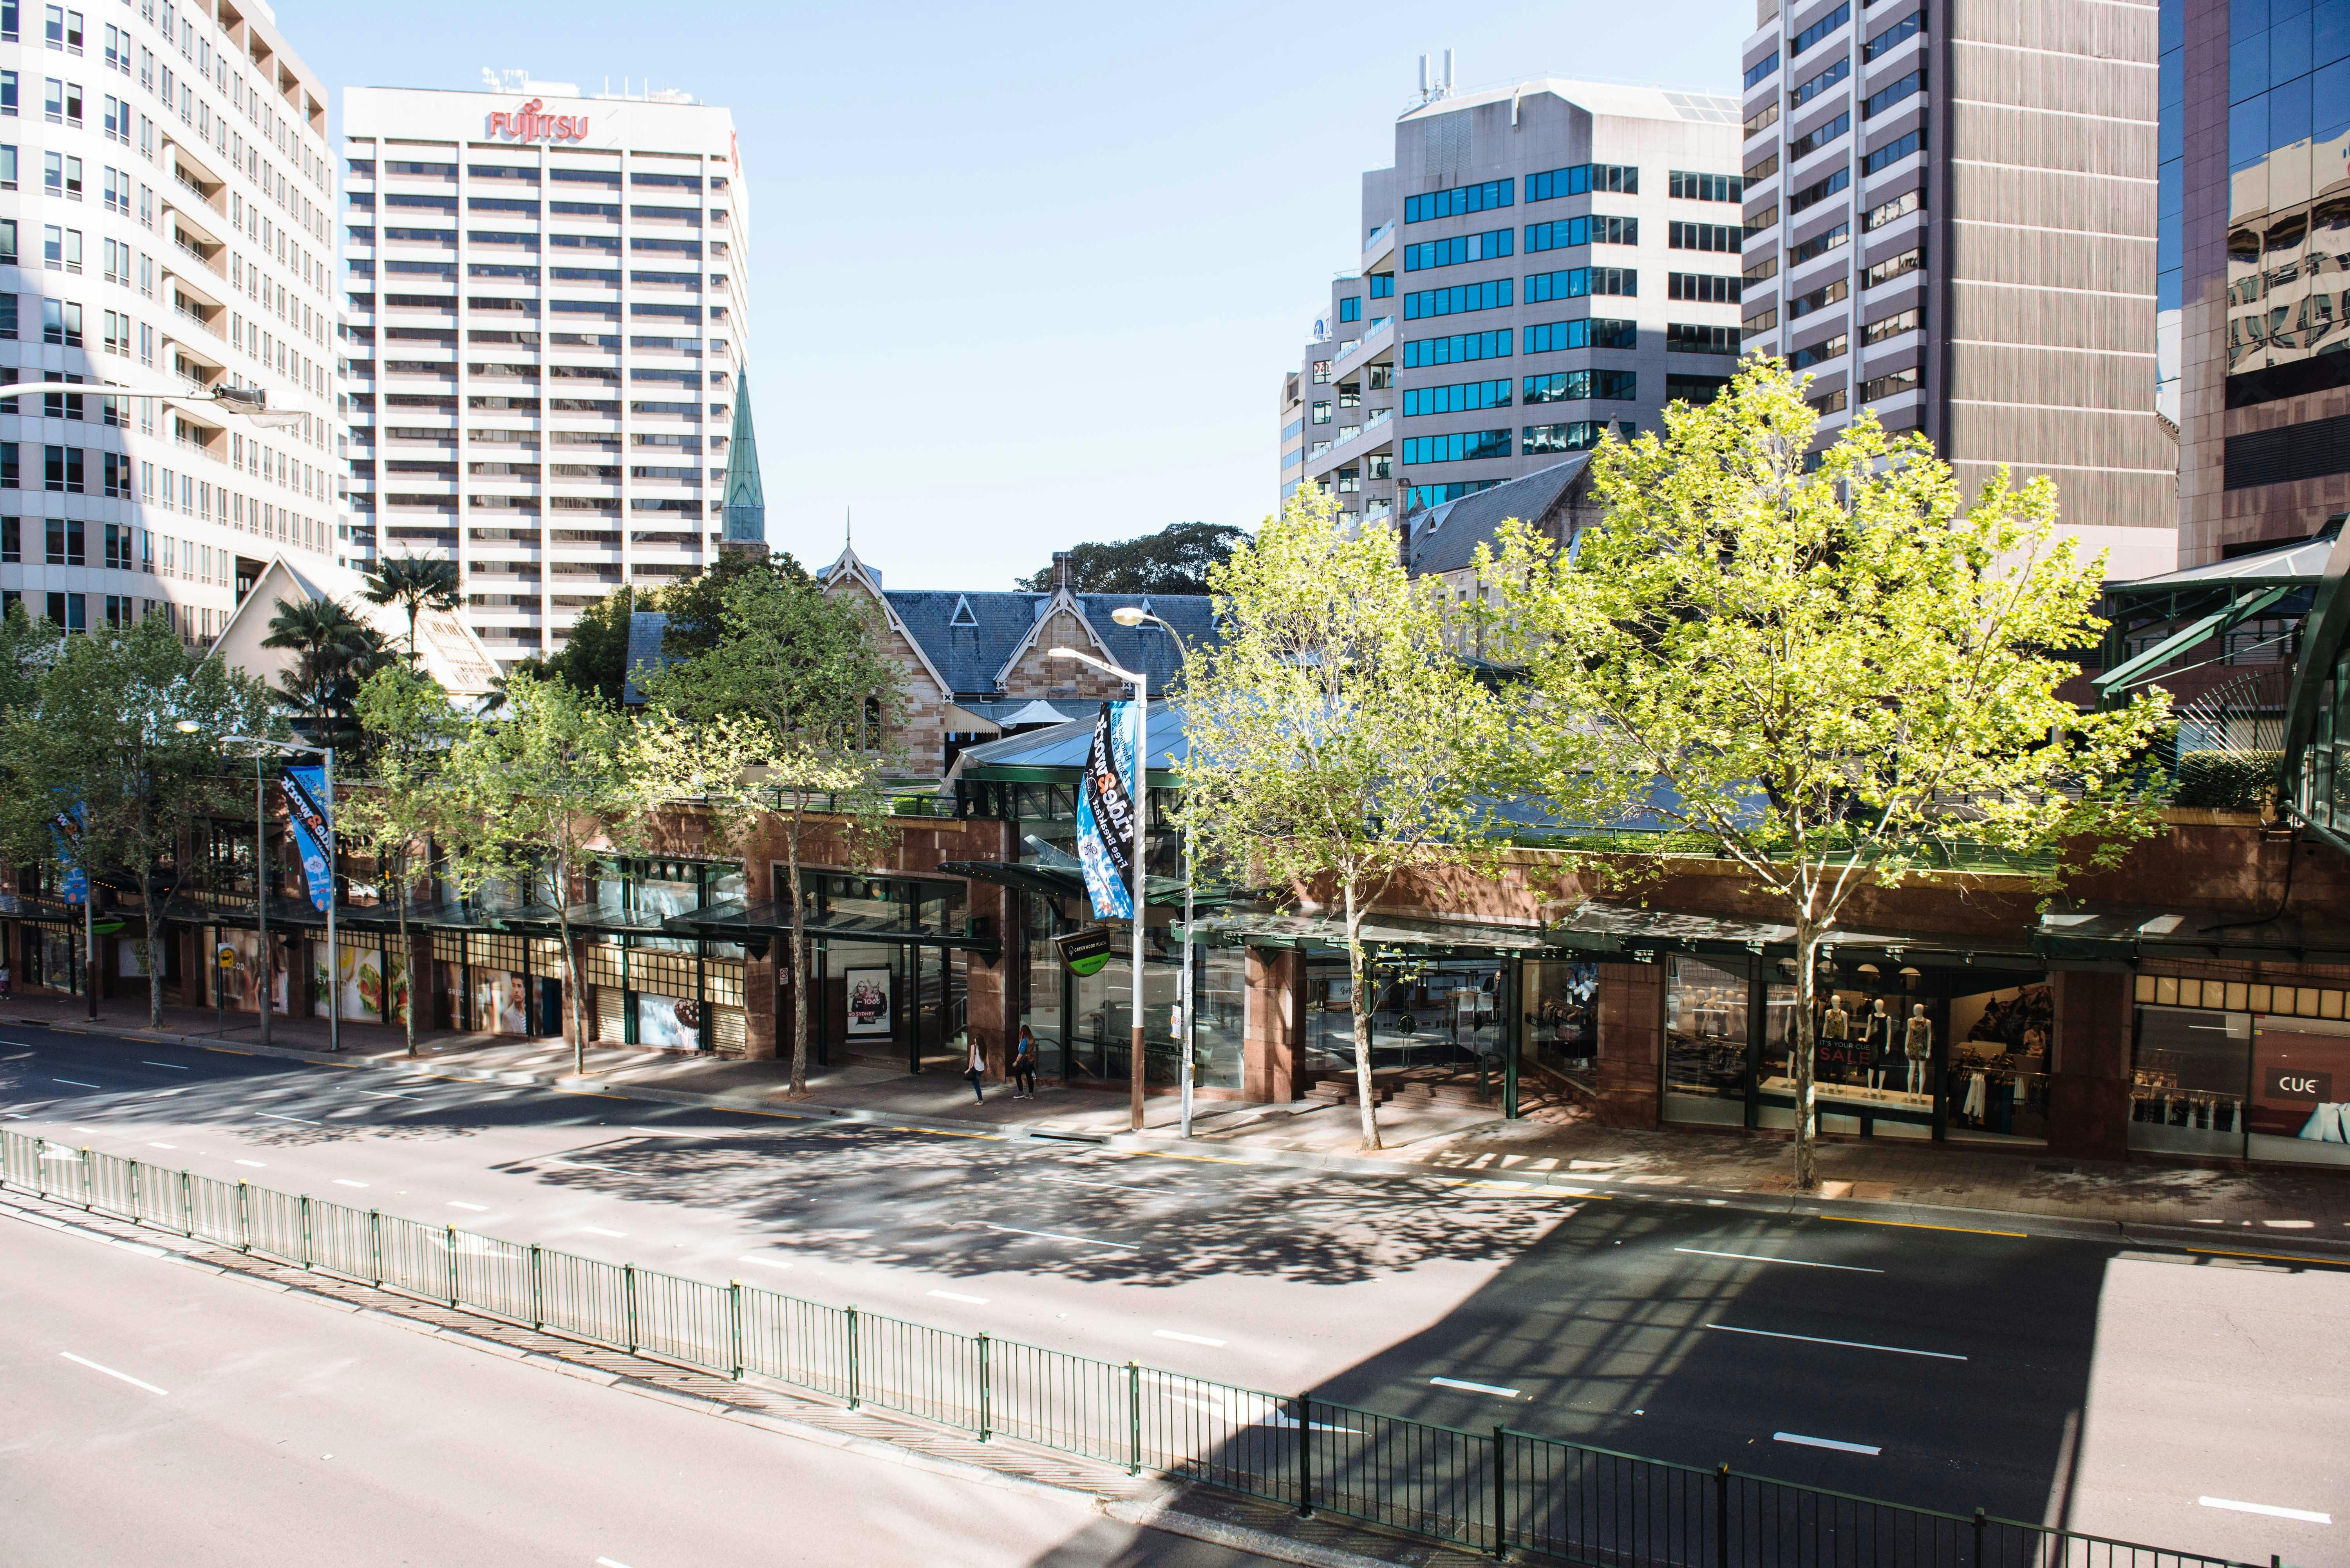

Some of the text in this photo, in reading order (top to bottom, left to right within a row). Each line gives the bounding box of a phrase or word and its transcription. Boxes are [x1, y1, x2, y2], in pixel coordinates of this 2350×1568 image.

[490, 98, 589, 144] FUJITSU
[1074, 943, 1095, 952] GREENWOOD
[1820, 1047, 1871, 1065] SALE
[2279, 1077, 2316, 1093] CUE
